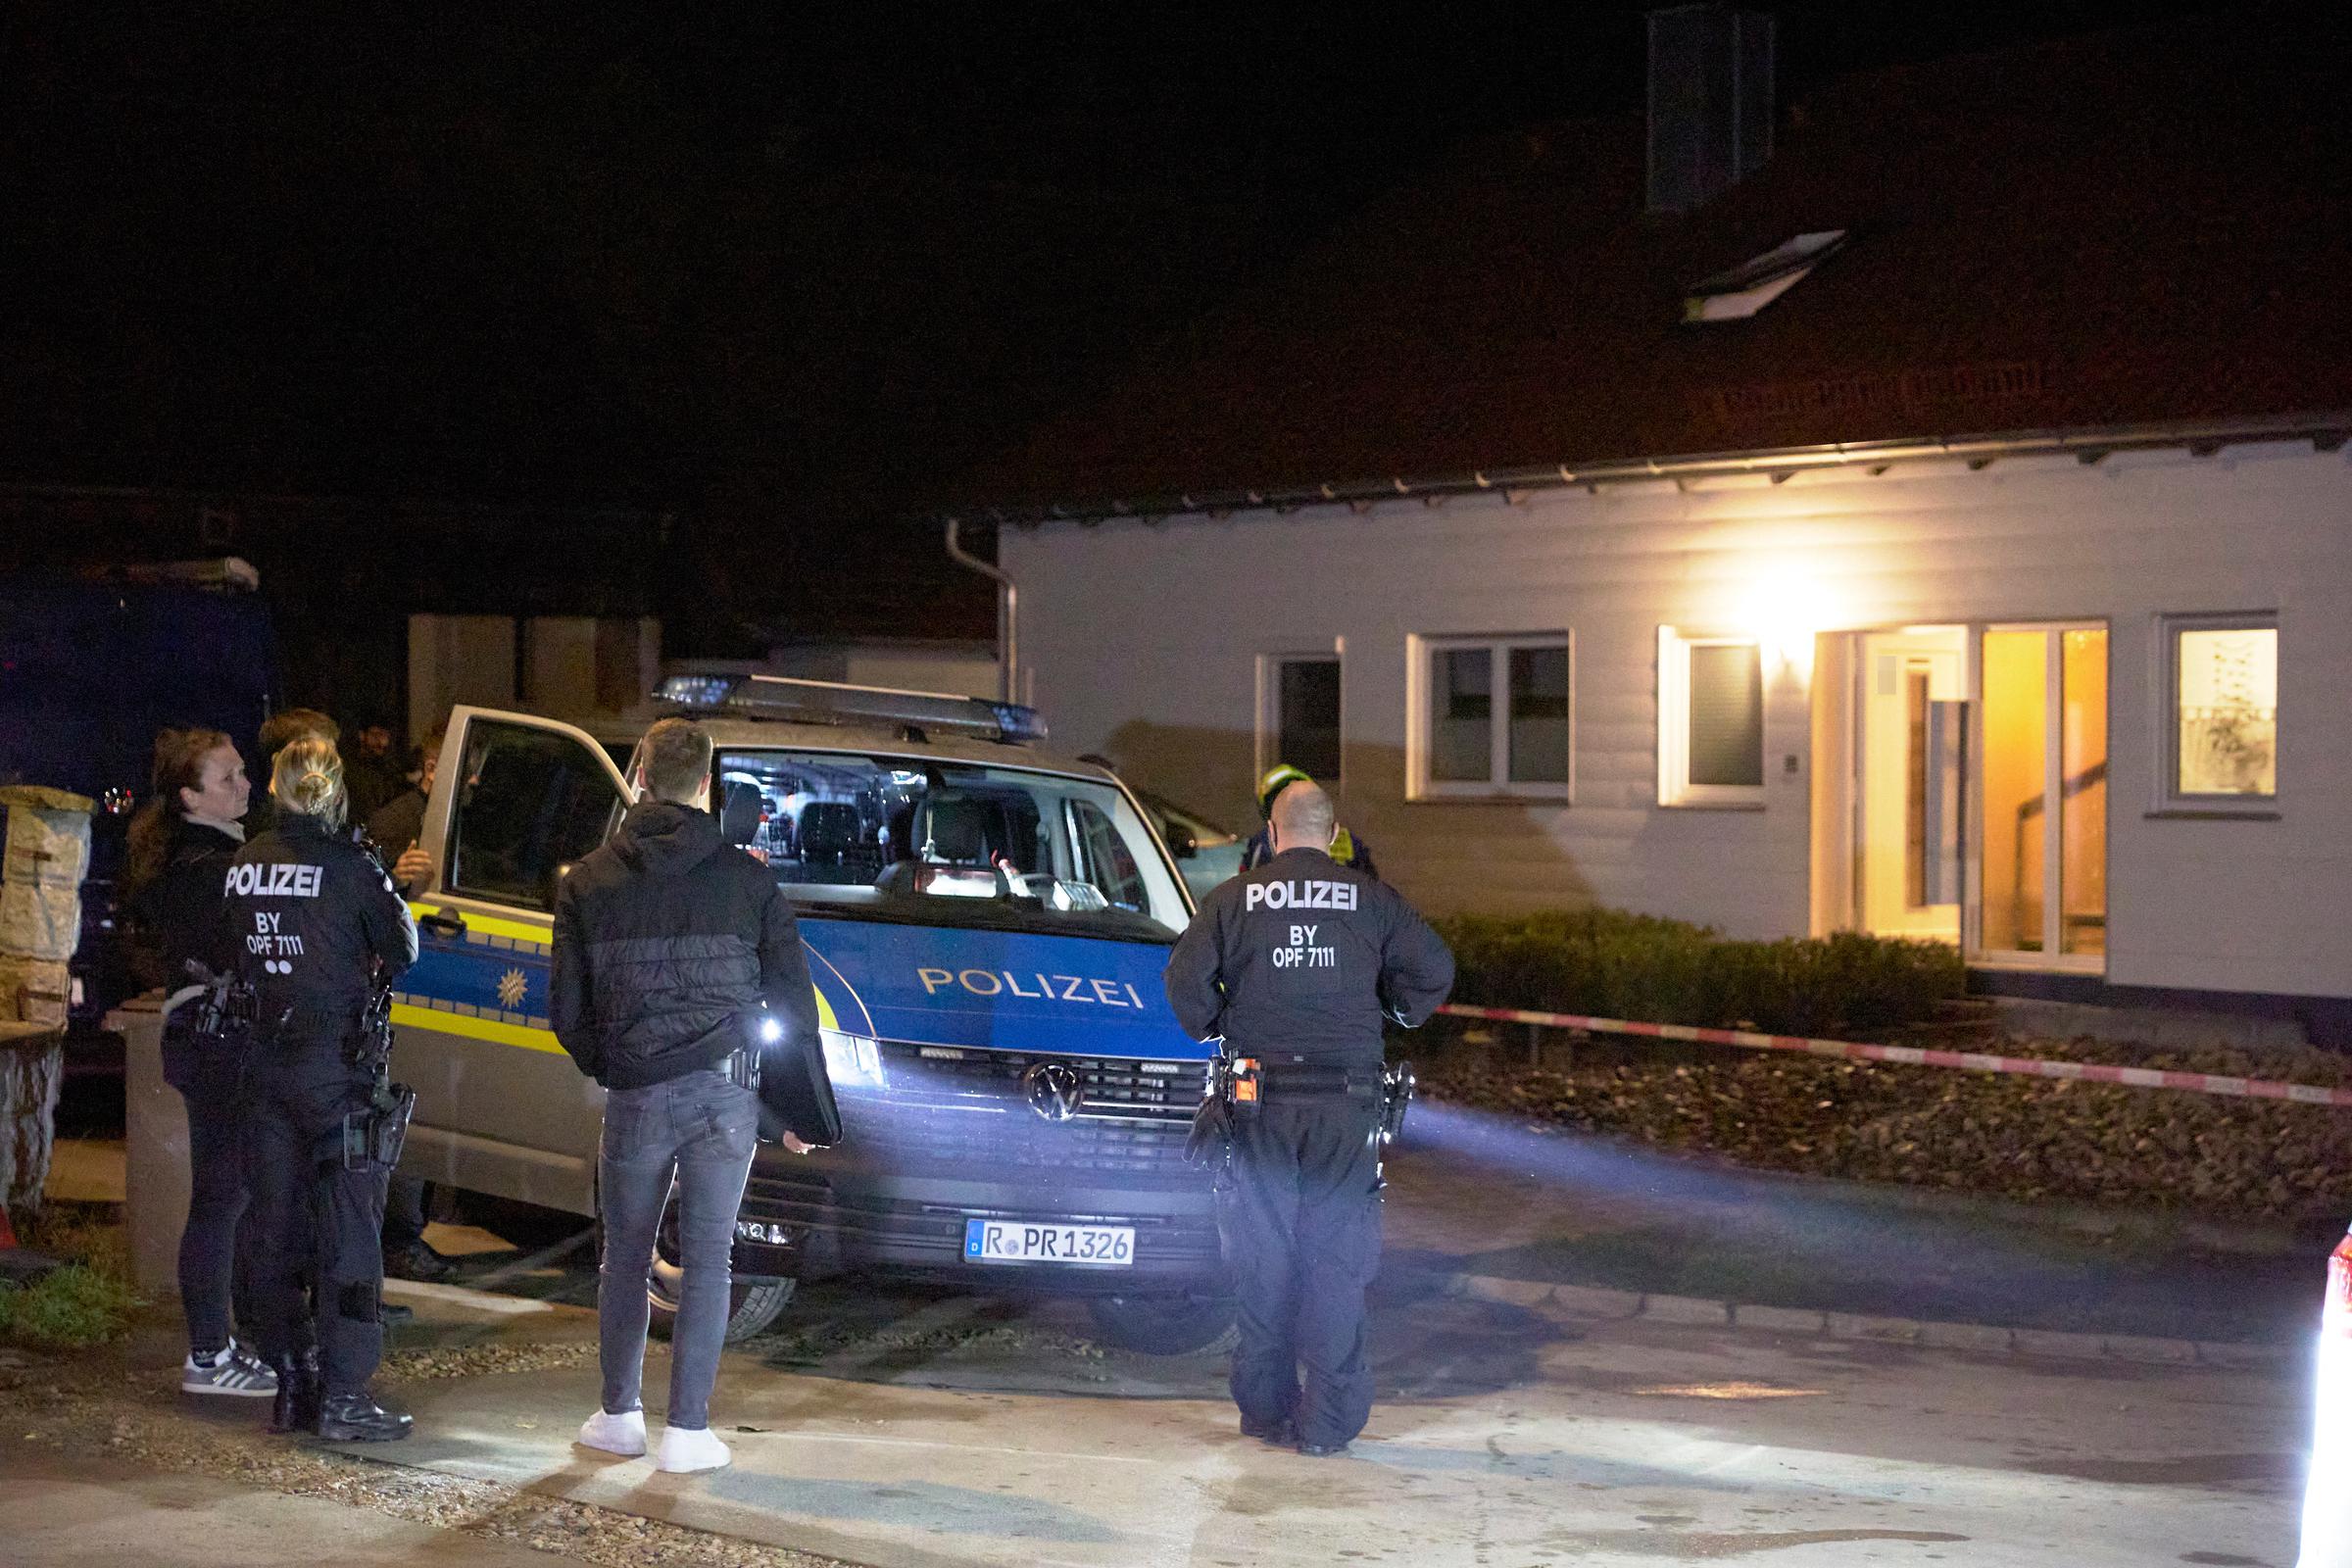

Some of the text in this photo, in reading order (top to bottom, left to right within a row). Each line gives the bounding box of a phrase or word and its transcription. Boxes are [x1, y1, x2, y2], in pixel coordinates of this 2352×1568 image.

[224, 863, 323, 897] POLIZEI
[1247, 880, 1357, 911] POLIZEI
[256, 912, 280, 933] BY
[247, 935, 304, 956] OPF 7111
[1290, 925, 1317, 946] BY
[1273, 947, 1334, 967] OPF 7111
[916, 968, 1144, 1008] POLIZEI
[985, 1227, 1002, 1253] R
